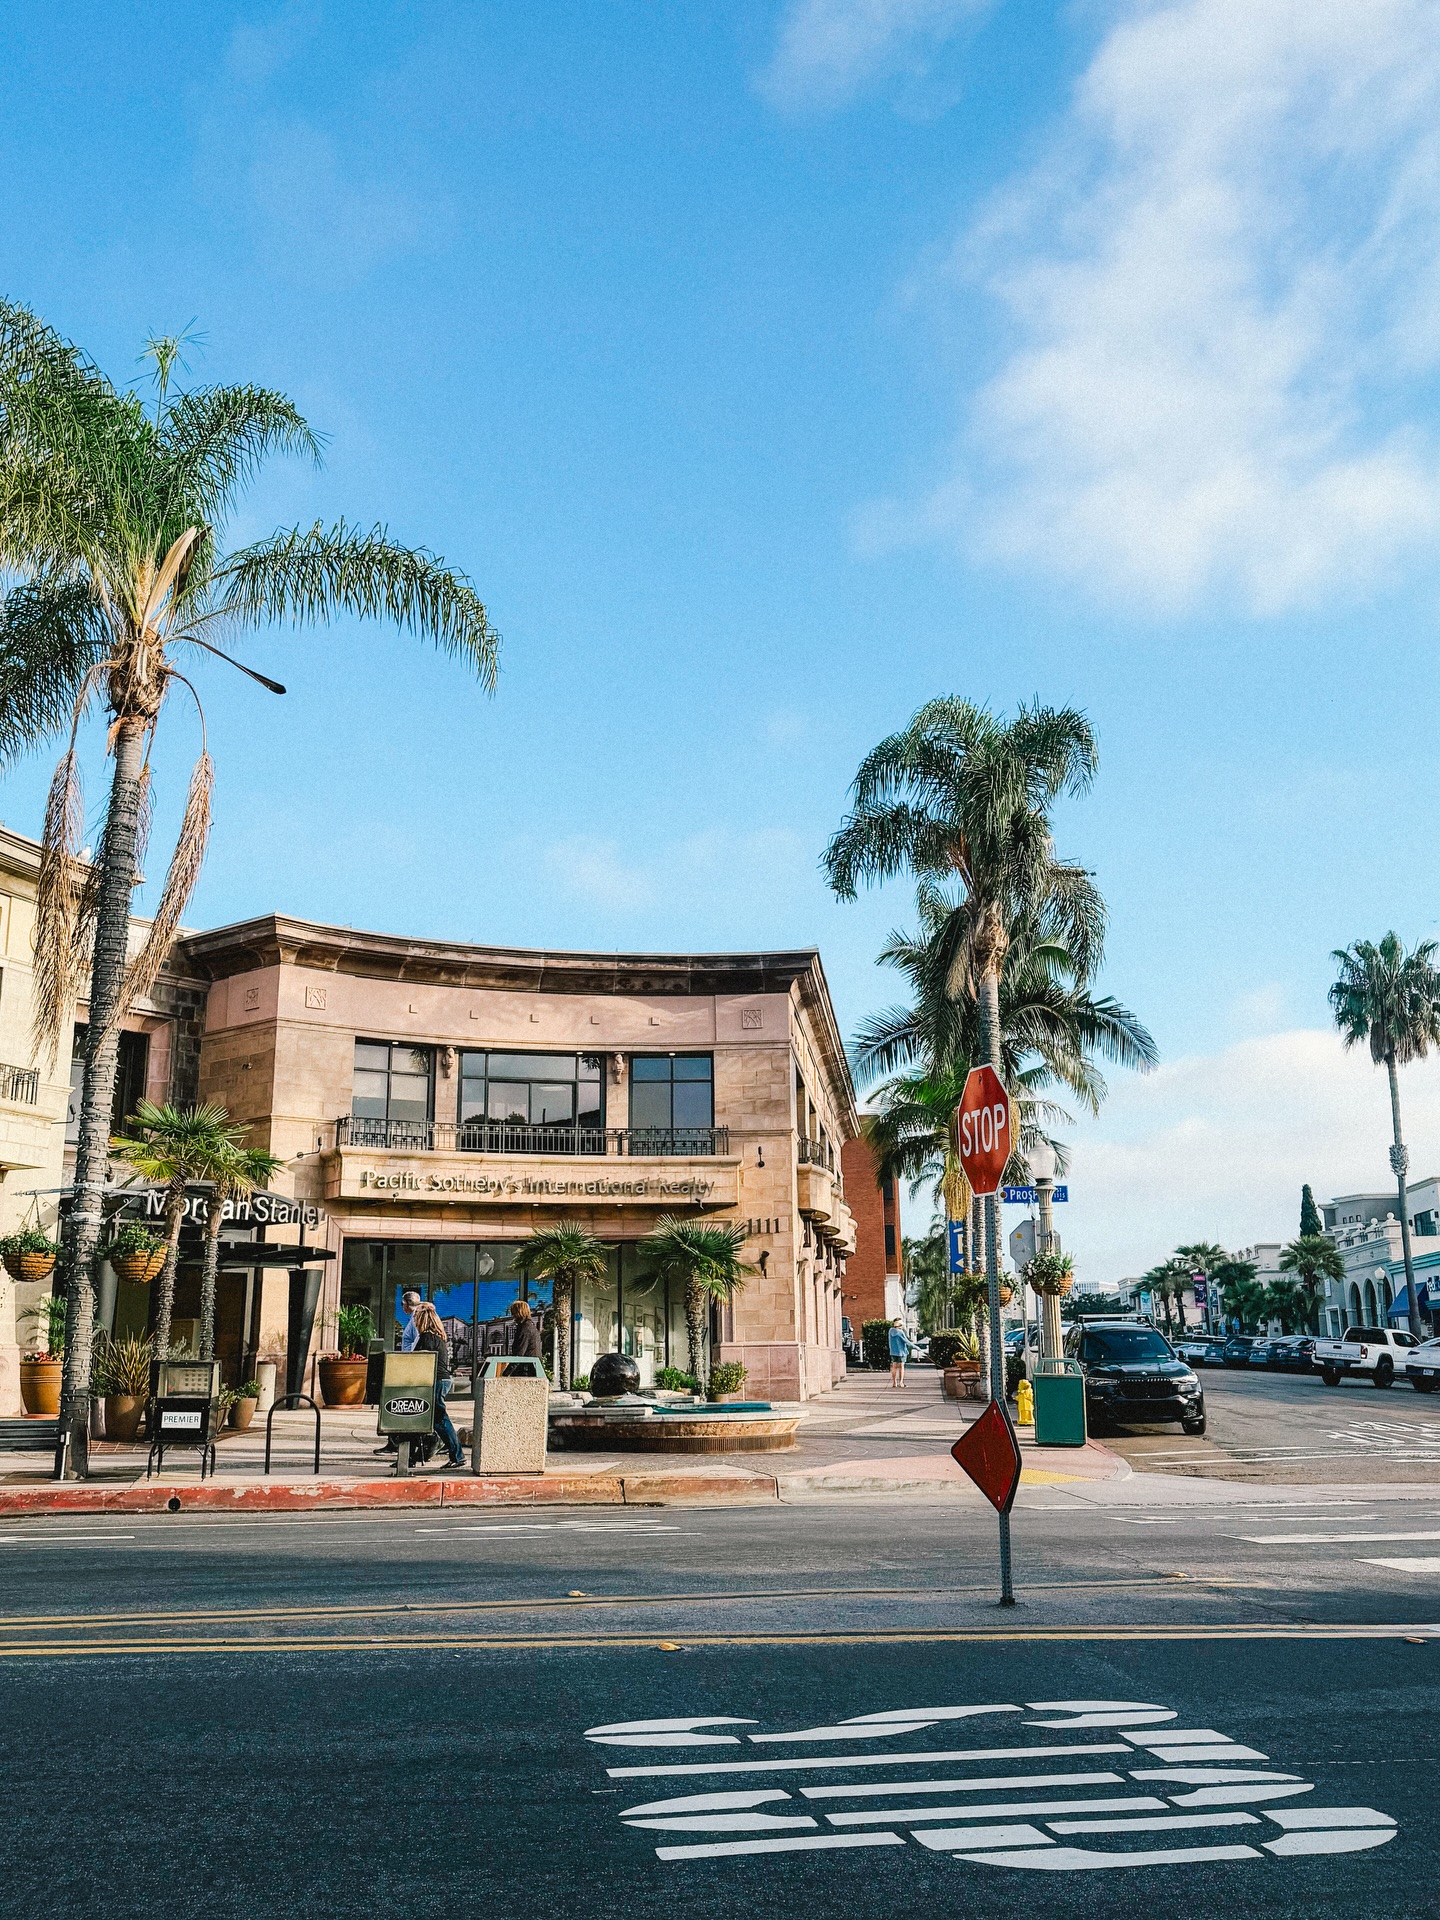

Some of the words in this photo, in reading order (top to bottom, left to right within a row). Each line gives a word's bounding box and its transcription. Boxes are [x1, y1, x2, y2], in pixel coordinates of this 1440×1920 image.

[962, 1103, 1006, 1157] STOP
[365, 1169, 425, 1190] Pacific
[431, 1173, 523, 1196] Sotheby's
[529, 1177, 651, 1196] International
[657, 1178, 716, 1198] Realty
[1010, 1189, 1039, 1201] PROSP
[255, 1196, 325, 1231] Stanley
[747, 1217, 780, 1234] 1111
[390, 1400, 424, 1410] DREAM
[163, 1415, 199, 1424] PREMIER
[583, 1700, 1399, 1871] STOP
